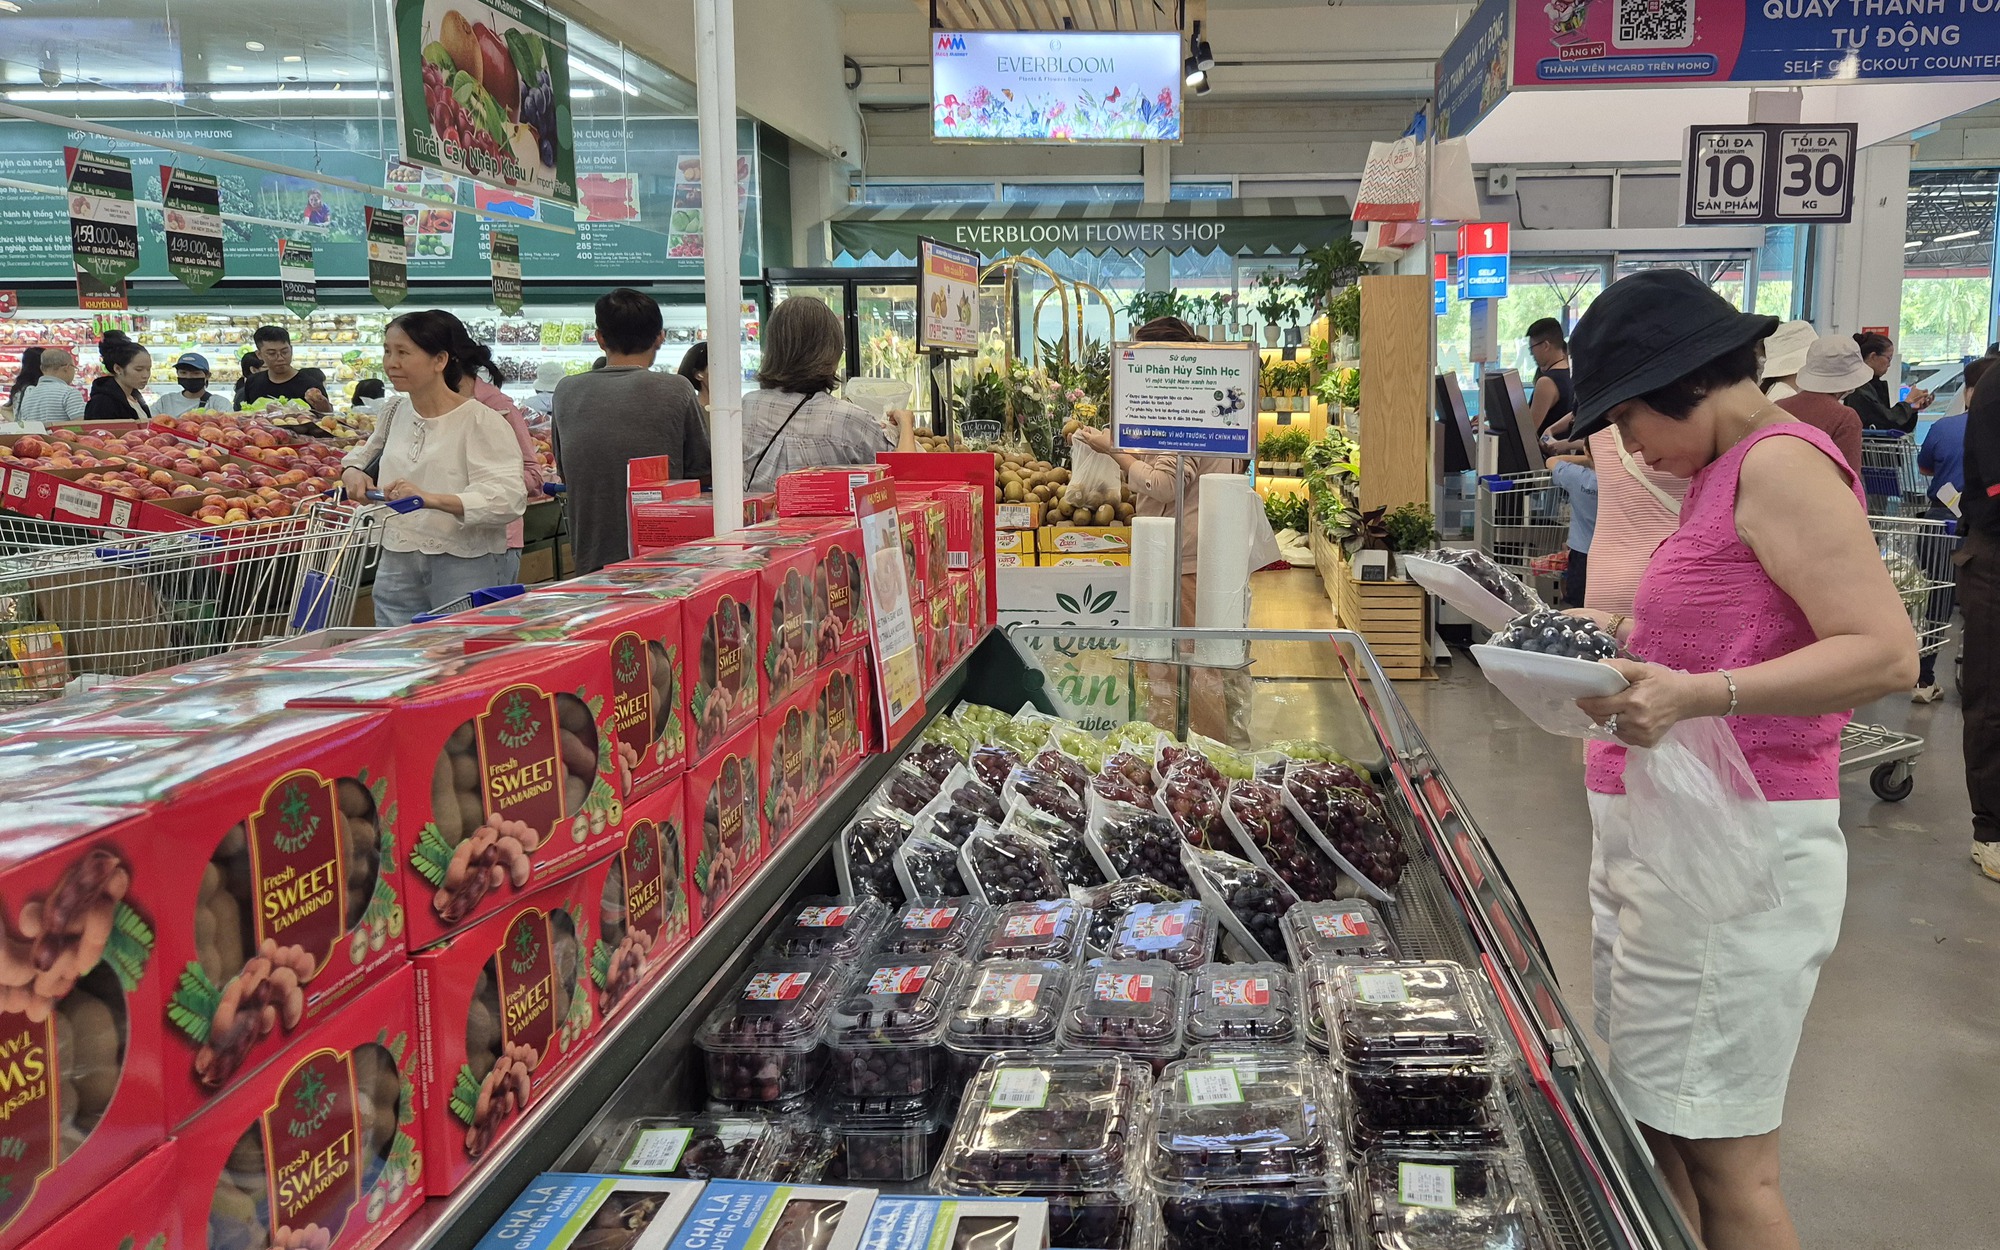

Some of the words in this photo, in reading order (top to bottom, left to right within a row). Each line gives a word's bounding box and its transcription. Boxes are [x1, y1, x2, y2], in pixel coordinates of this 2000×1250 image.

[1876, 21, 1961, 53] ĐỘNG
[997, 56, 1114, 74] EVERBLOOM
[1544, 61, 1579, 74] THÀNH
[1581, 61, 1605, 73] VIÊN
[1608, 63, 1645, 73] MCARD
[1647, 59, 1675, 71] TRÊN
[1677, 61, 1710, 71] MOMO
[1784, 60, 1824, 73] SELF
[1067, 76, 1094, 84] Boutique
[177, 130, 192, 140] ĐỊA
[194, 130, 232, 139] PHƯƠNG
[586, 130, 610, 139] CUNG
[1708, 134, 1729, 148] TỐI
[1734, 138, 1754, 148] ĐA
[1791, 133, 1812, 147] TỐI
[1817, 137, 1838, 147] ĐA
[413, 129, 440, 157] Trái
[443, 140, 467, 170] Cây
[469, 148, 499, 178] Nhập
[502, 155, 527, 181] Khẩu
[536, 176, 555, 192] Import
[593, 154, 617, 164] ĐỒNG
[1706, 155, 1754, 197] 10
[1783, 154, 1844, 197] 30
[1697, 198, 1722, 211] SẢN
[1725, 197, 1759, 210] PHẨM
[1802, 200, 1818, 209] KG
[479, 224, 490, 232] 40
[480, 233, 490, 241] 30
[581, 233, 591, 241] 80
[956, 224, 1079, 243] EVERBLOOM
[1086, 223, 1165, 242] FLOWER
[1172, 222, 1226, 240] SHOP
[1483, 227, 1493, 249] 1
[479, 252, 492, 260] 150
[577, 252, 592, 260] 400
[1469, 276, 1506, 285] CHECKOUT
[85, 299, 110, 310] KHUYẾN
[1180, 355, 1197, 364] dụng
[1128, 364, 1143, 374] Túi
[1146, 365, 1170, 375] Phân
[1173, 365, 1192, 378] Hủy
[1196, 366, 1218, 376] Sinh
[1220, 367, 1240, 379] Học
[1164, 377, 1175, 385] Việt
[829, 587, 849, 602] SWEET
[785, 614, 802, 632] SWEET
[719, 647, 742, 670] SWEET
[615, 661, 642, 684] NATCHA
[614, 692, 649, 723] SWEET
[616, 711, 647, 733] TAMARIND
[497, 720, 542, 749] NATCHA
[489, 756, 519, 777] Fresh
[491, 756, 556, 798] SWEET
[498, 780, 553, 810] TAMARIND
[721, 803, 743, 833] SWEET
[272, 815, 322, 855] NATCHA
[263, 865, 296, 893] Fresh
[264, 858, 337, 920] SWEET
[629, 879, 644, 896] Fresh
[629, 875, 660, 914] SWEET
[272, 889, 334, 934] TAMARIND
[633, 894, 660, 923] TAMARIND
[510, 942, 541, 975] NATCHA
[506, 983, 527, 1007] Fresh
[507, 974, 552, 1027] SWEET
[512, 999, 550, 1037] TAMARIND
[288, 1091, 338, 1139] NATCHA
[277, 1149, 311, 1182] Fresh
[279, 1129, 354, 1207] SWEET
[287, 1160, 349, 1218] TAMARIND
[497, 1207, 536, 1239] CHÀ
[528, 1184, 558, 1204] LÀ
[685, 1213, 721, 1249] CHÀ
[714, 1192, 736, 1213] LÀ
